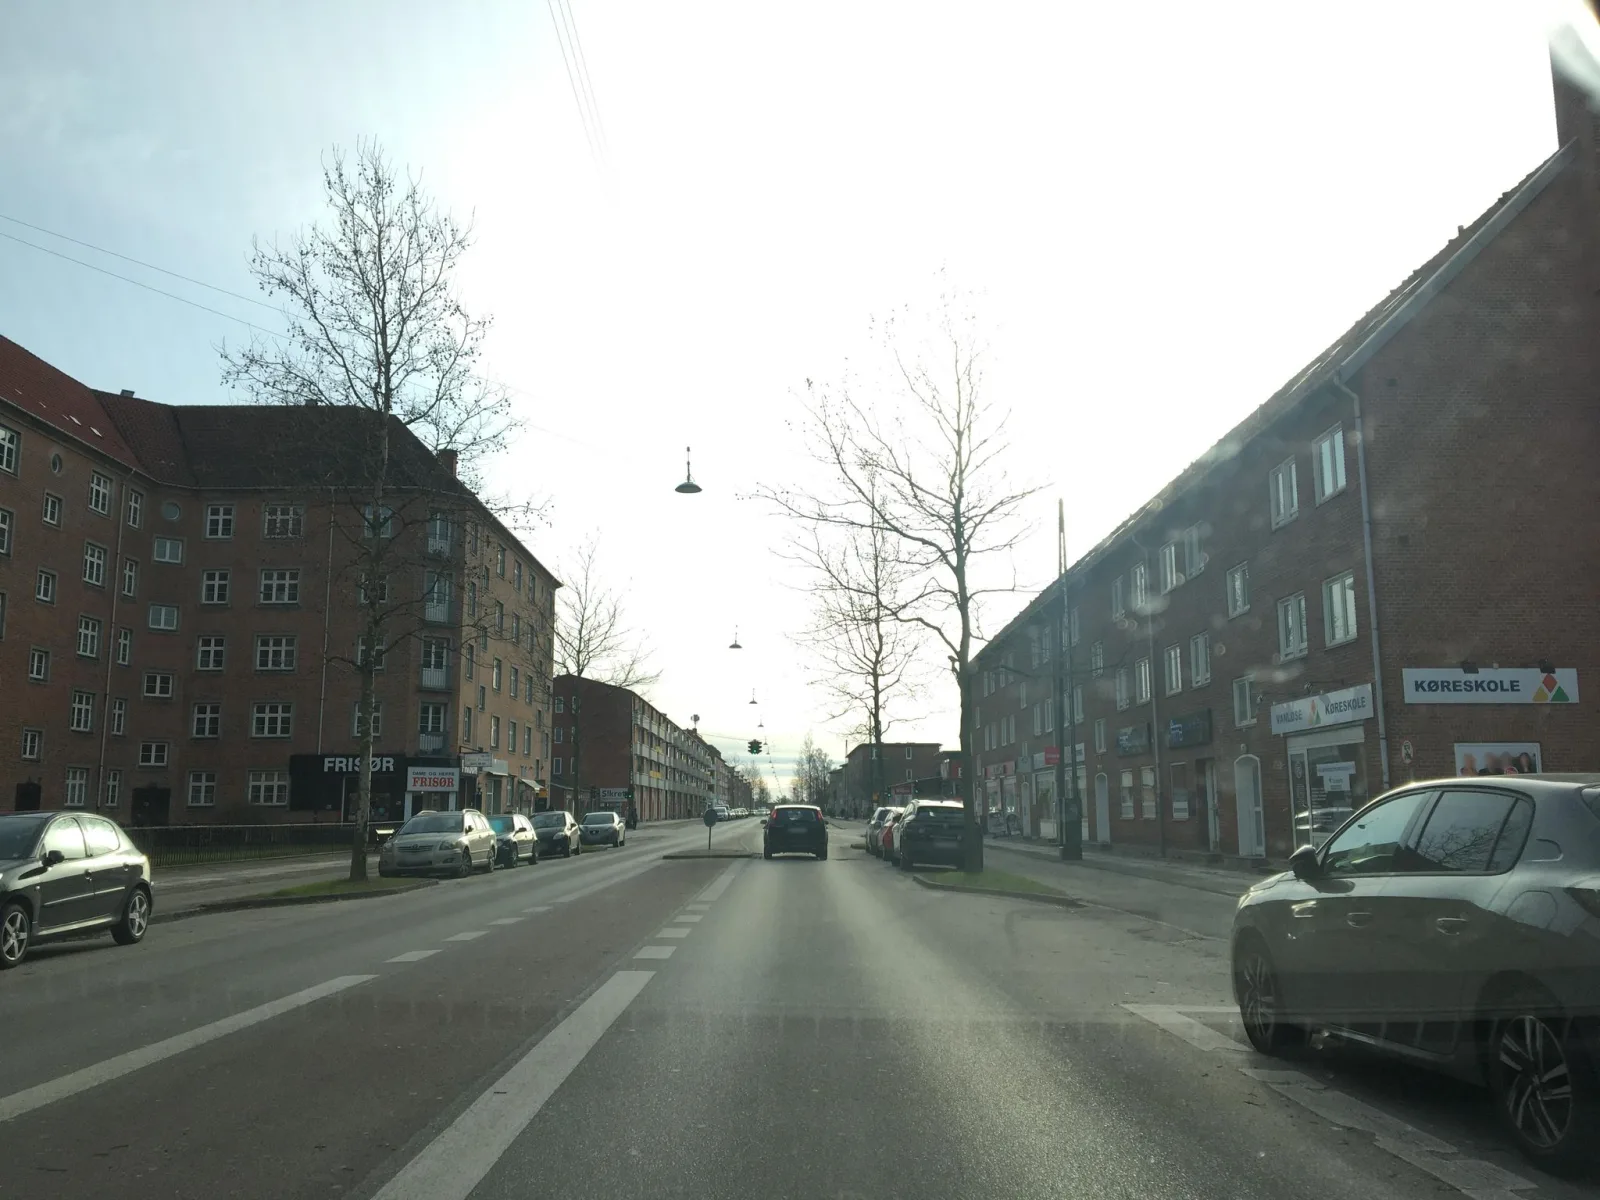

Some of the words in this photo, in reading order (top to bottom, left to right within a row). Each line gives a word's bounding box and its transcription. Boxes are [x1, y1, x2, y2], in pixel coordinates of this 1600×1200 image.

[1414, 680, 1521, 692] KØRESKOLE
[1325, 696, 1366, 715] KØRESKOLE
[412, 776, 454, 788] FRISØR
